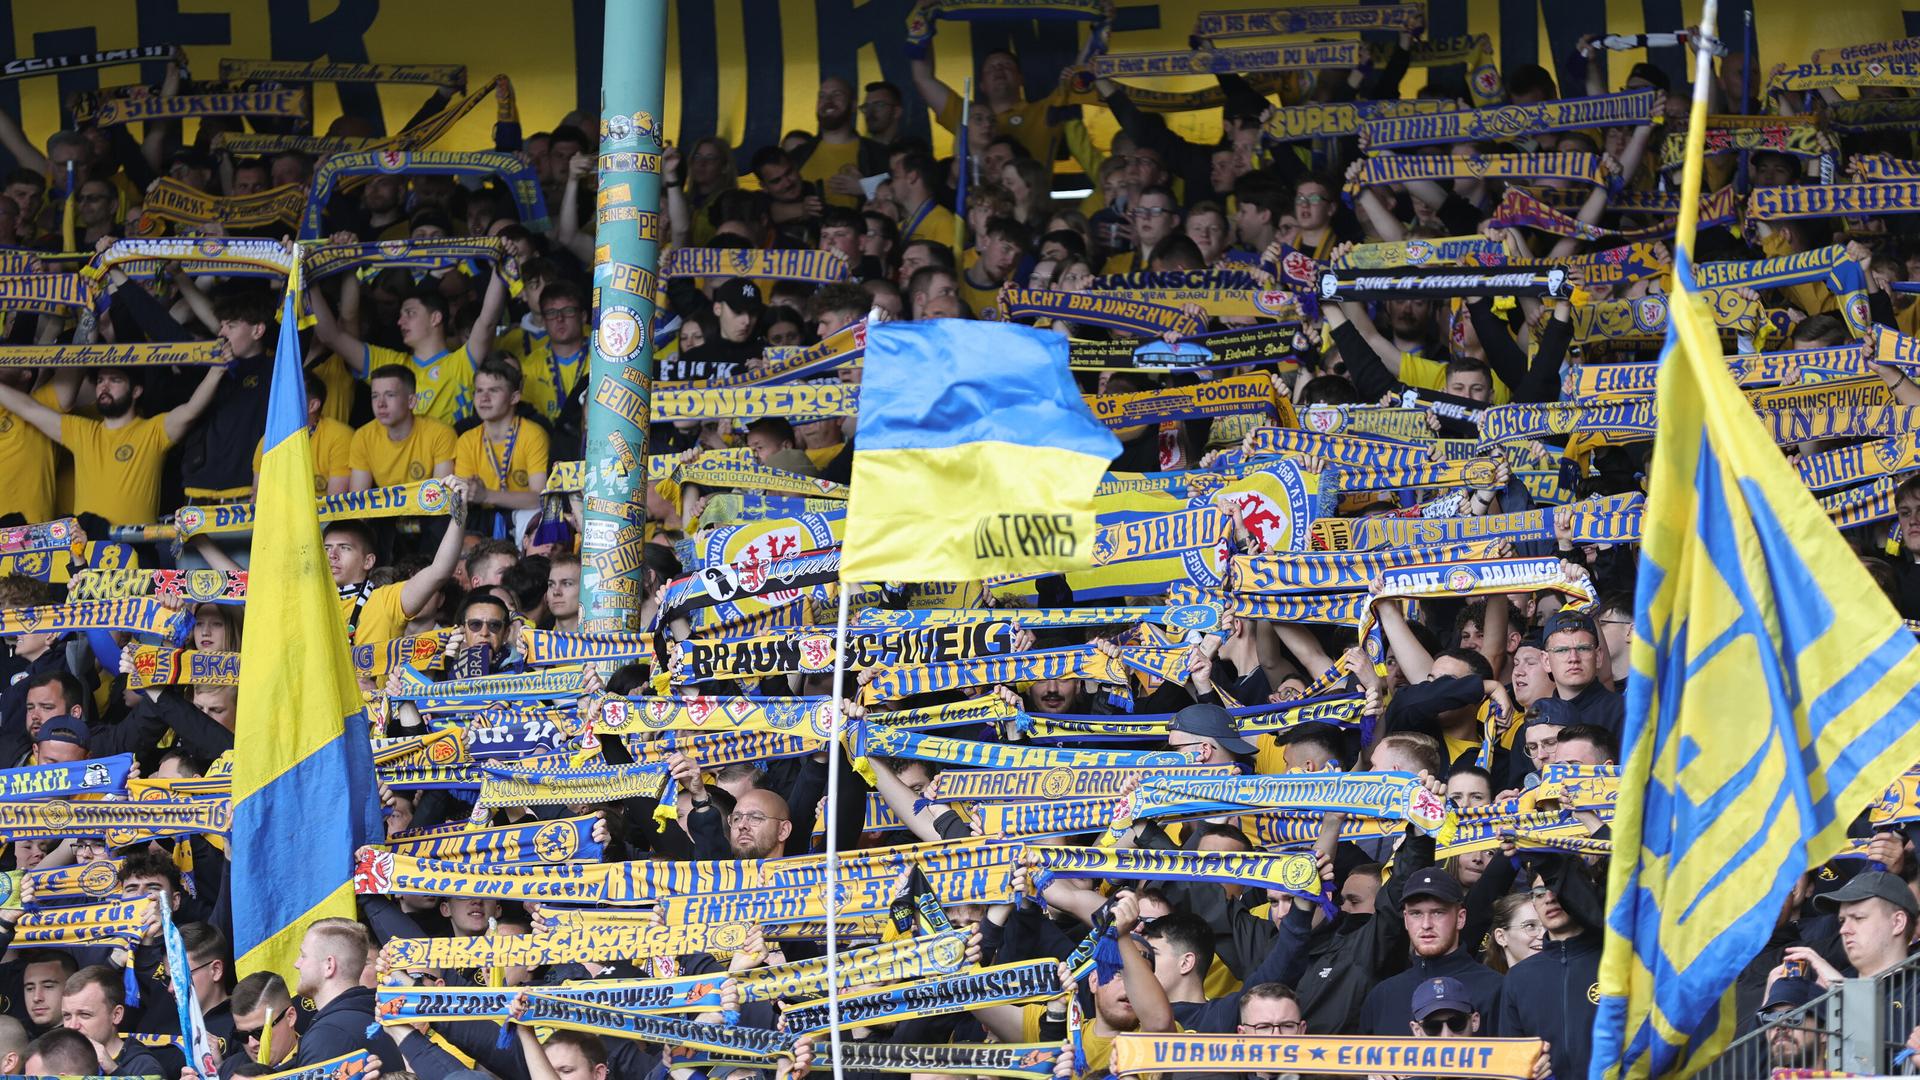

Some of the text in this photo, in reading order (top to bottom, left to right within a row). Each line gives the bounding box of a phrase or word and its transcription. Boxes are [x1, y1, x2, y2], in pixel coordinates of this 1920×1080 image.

[1840, 35, 1920, 61] GEGEN RAS
[1798, 61, 1920, 78] BLAU GE
[1268, 104, 1357, 138] SUPER
[640, 213, 658, 239] PE
[670, 249, 722, 274] RACHT
[1354, 276, 1393, 290] RUHE
[1417, 275, 1484, 289] FRIEDEN
[1008, 289, 1064, 308] RACHT
[659, 360, 740, 382] FUCK
[1196, 384, 1270, 403] FOOTBALL
[1096, 401, 1117, 416] OF
[707, 472, 812, 491] ICH DENKEN KANN
[974, 513, 1076, 560] ULTRAS
[1126, 510, 1216, 557] STADIO
[1366, 509, 1544, 550] AUFSTEIGER
[1519, 533, 1544, 541] DER
[693, 635, 801, 680] BRAUN
[1298, 701, 1365, 721] EUCH
[693, 728, 804, 765] STADION
[915, 737, 1129, 768] EINTRACHT
[10, 767, 72, 796] MAUL
[939, 771, 1041, 795] EINTRACHT
[74, 801, 228, 828] BRAUNSCHWEIG
[1041, 849, 1281, 879] SIND EINTRACHT
[397, 875, 600, 898] STADT UND VEREIN
[95, 901, 135, 922] FÜR
[685, 886, 811, 925] EINTRACHT
[414, 993, 508, 1015] DALTONS
[1154, 1038, 1494, 1069] VORWÄRTS EINTRACHT
